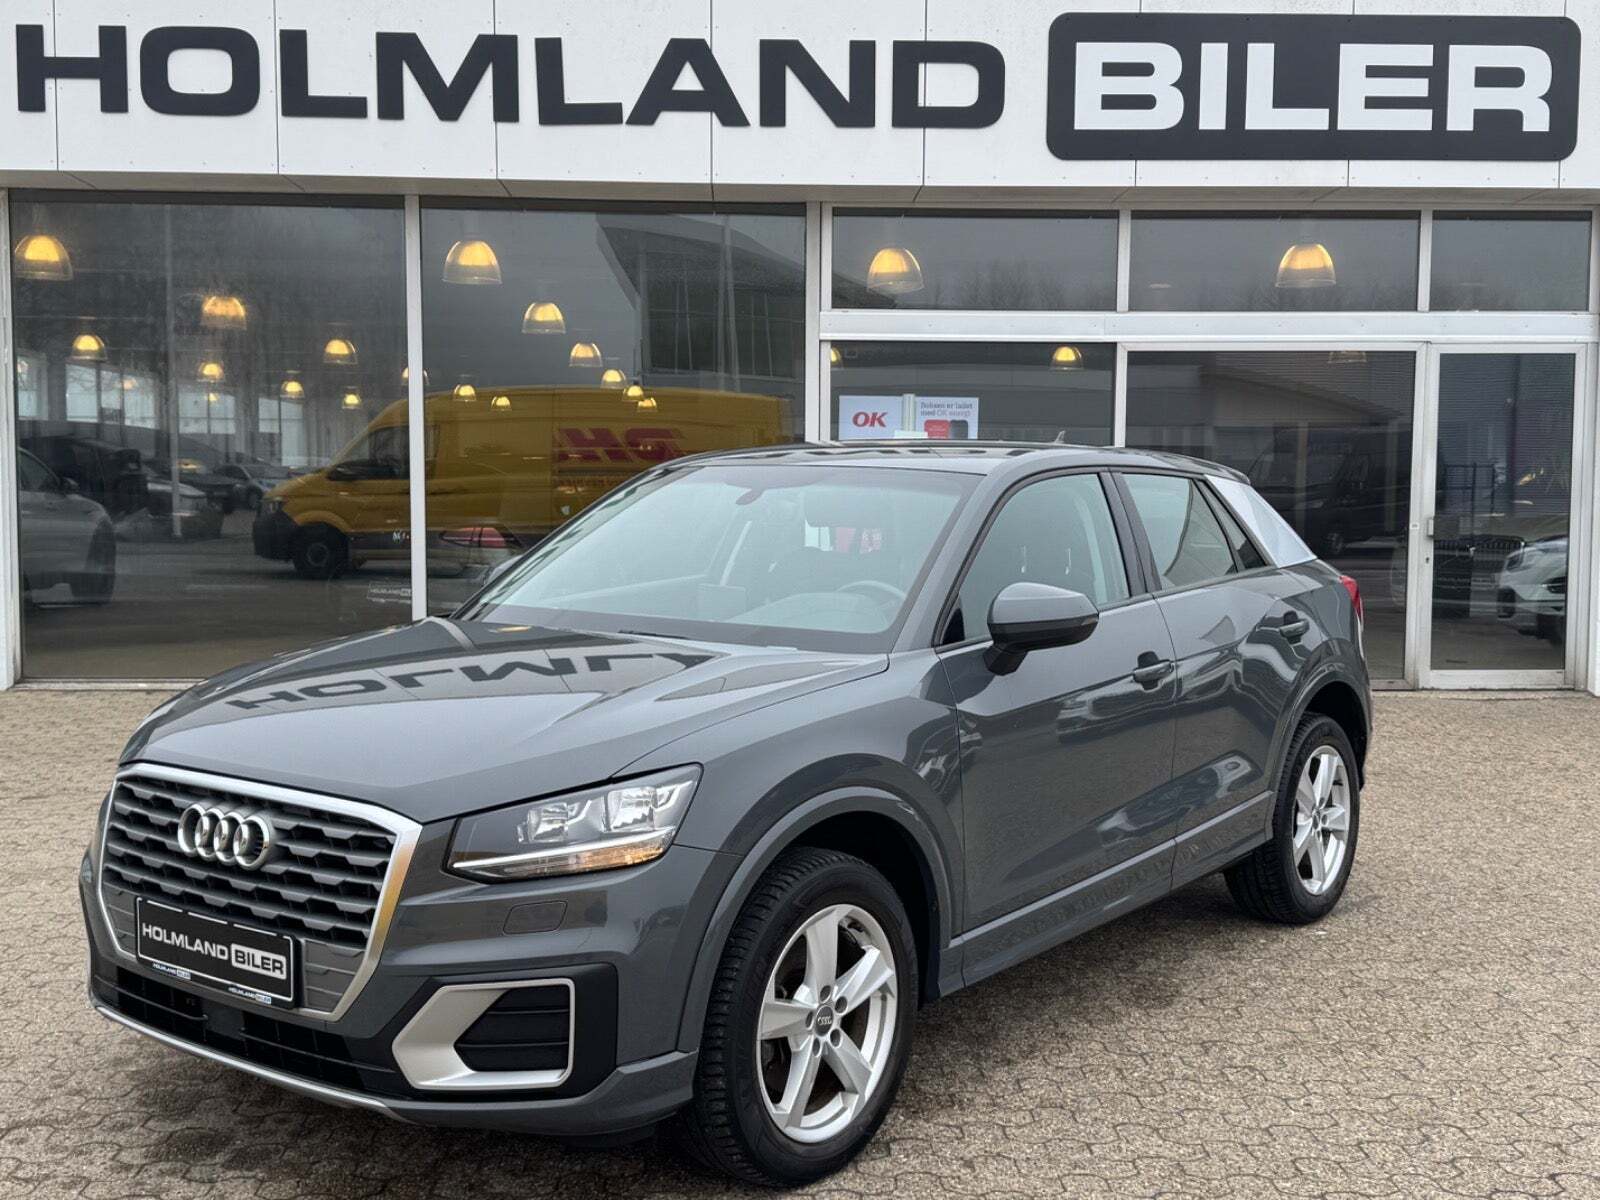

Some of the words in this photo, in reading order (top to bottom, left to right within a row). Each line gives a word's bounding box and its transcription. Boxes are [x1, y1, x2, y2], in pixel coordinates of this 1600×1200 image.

[16, 24, 1005, 128] HOLMLAND
[1074, 42, 1553, 132] BILER
[852, 411, 888, 427] OK
[142, 922, 229, 960] HOLMLAND
[235, 950, 285, 975] BILER
